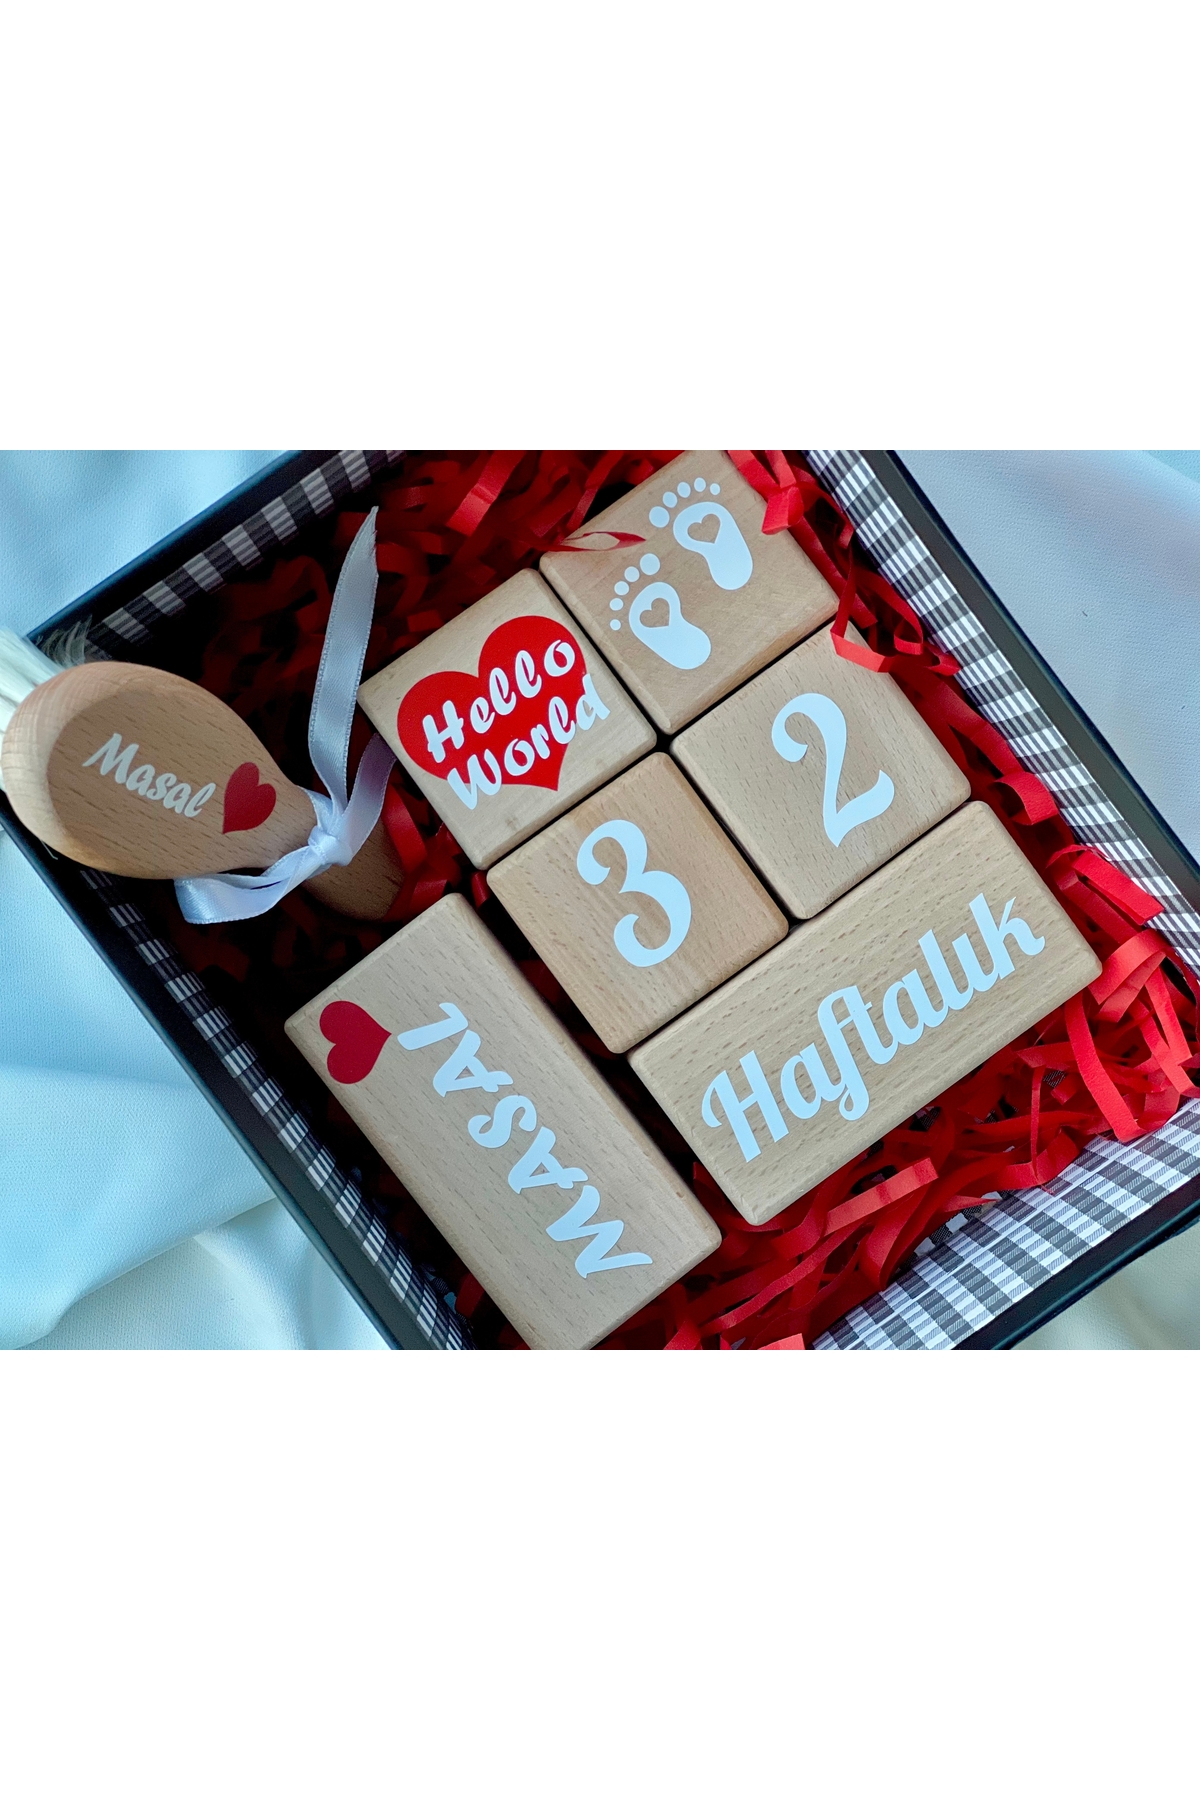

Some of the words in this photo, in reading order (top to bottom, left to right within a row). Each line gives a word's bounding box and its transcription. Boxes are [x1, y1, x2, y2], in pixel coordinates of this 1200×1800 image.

[421, 639, 576, 763] Hello
[446, 673, 610, 811] World
[770, 691, 896, 849] 2
[82, 732, 218, 818] Masal
[576, 818, 693, 969] 3
[397, 1002, 653, 1279] MASAL
